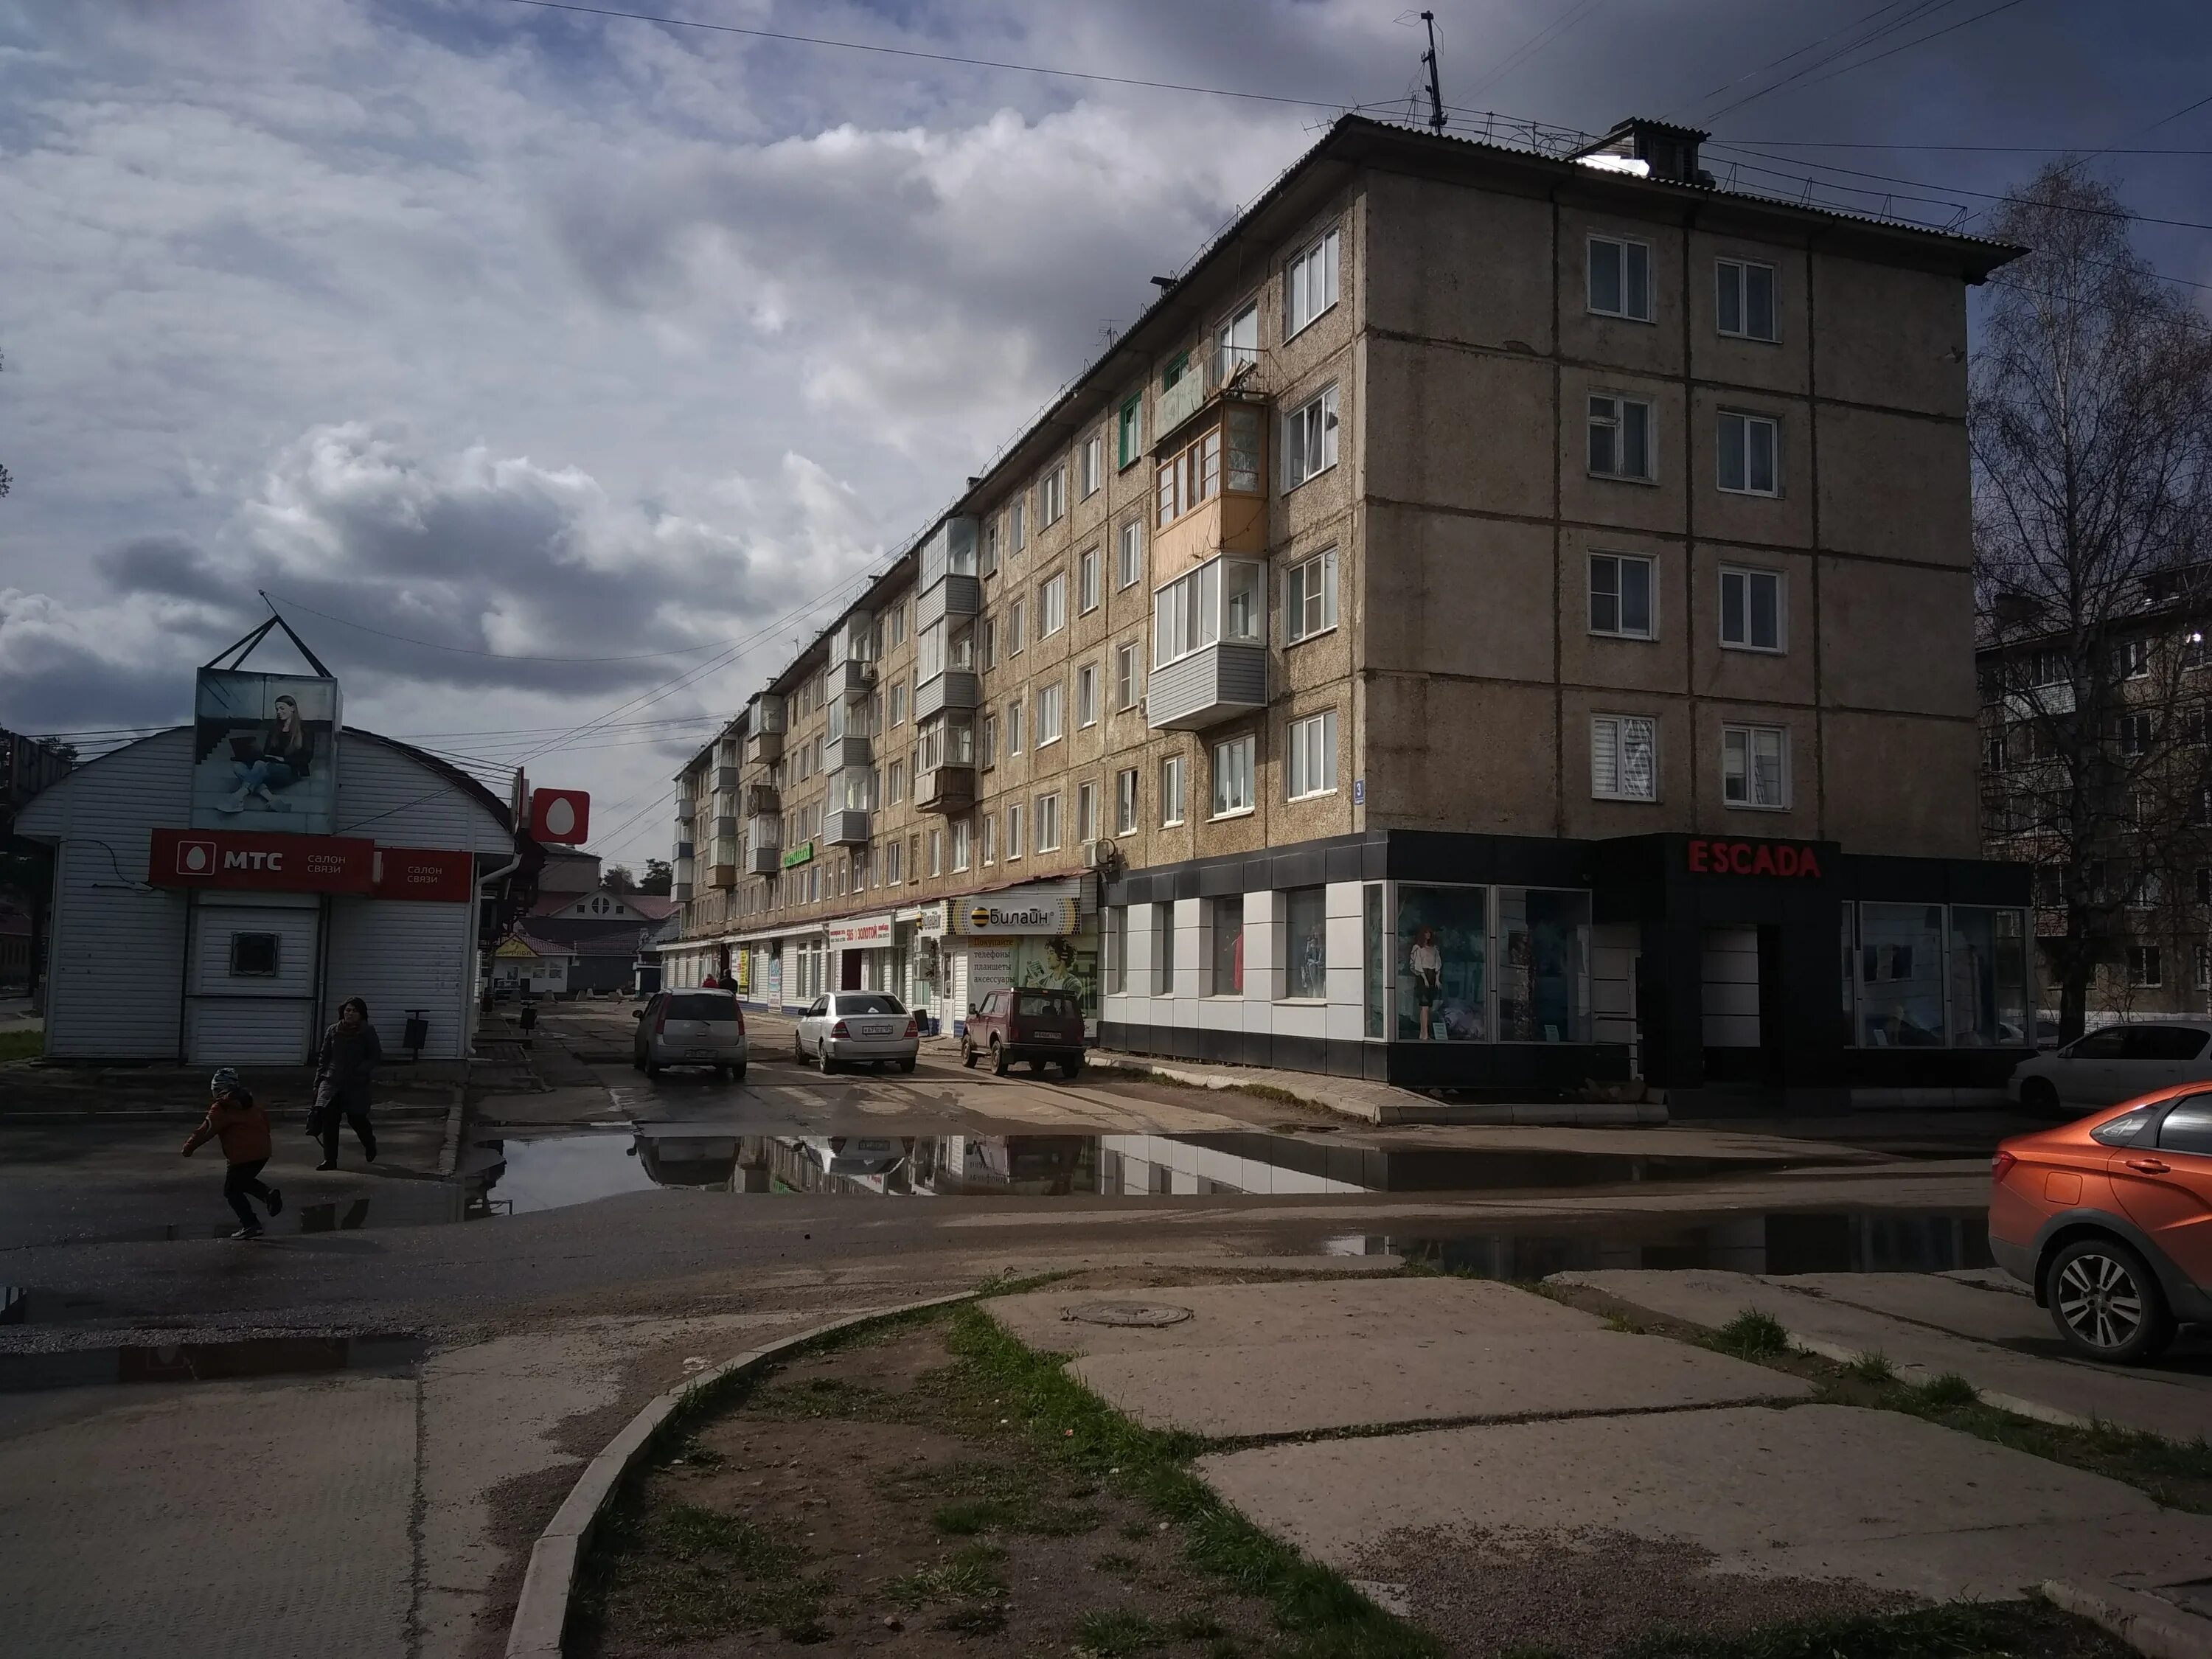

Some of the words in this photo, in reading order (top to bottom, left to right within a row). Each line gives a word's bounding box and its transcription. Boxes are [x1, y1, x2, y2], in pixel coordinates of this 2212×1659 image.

[1356, 782, 1361, 796] 3
[223, 851, 283, 871] МТС
[307, 855, 346, 864] салон
[1687, 839, 1823, 879] ESCADA
[307, 865, 341, 874] связи
[407, 866, 442, 874] салон
[406, 875, 438, 884] связи
[974, 937, 1014, 947] Покупайте
[973, 950, 1011, 960] телефоны
[973, 976, 1015, 985] аксессуары
